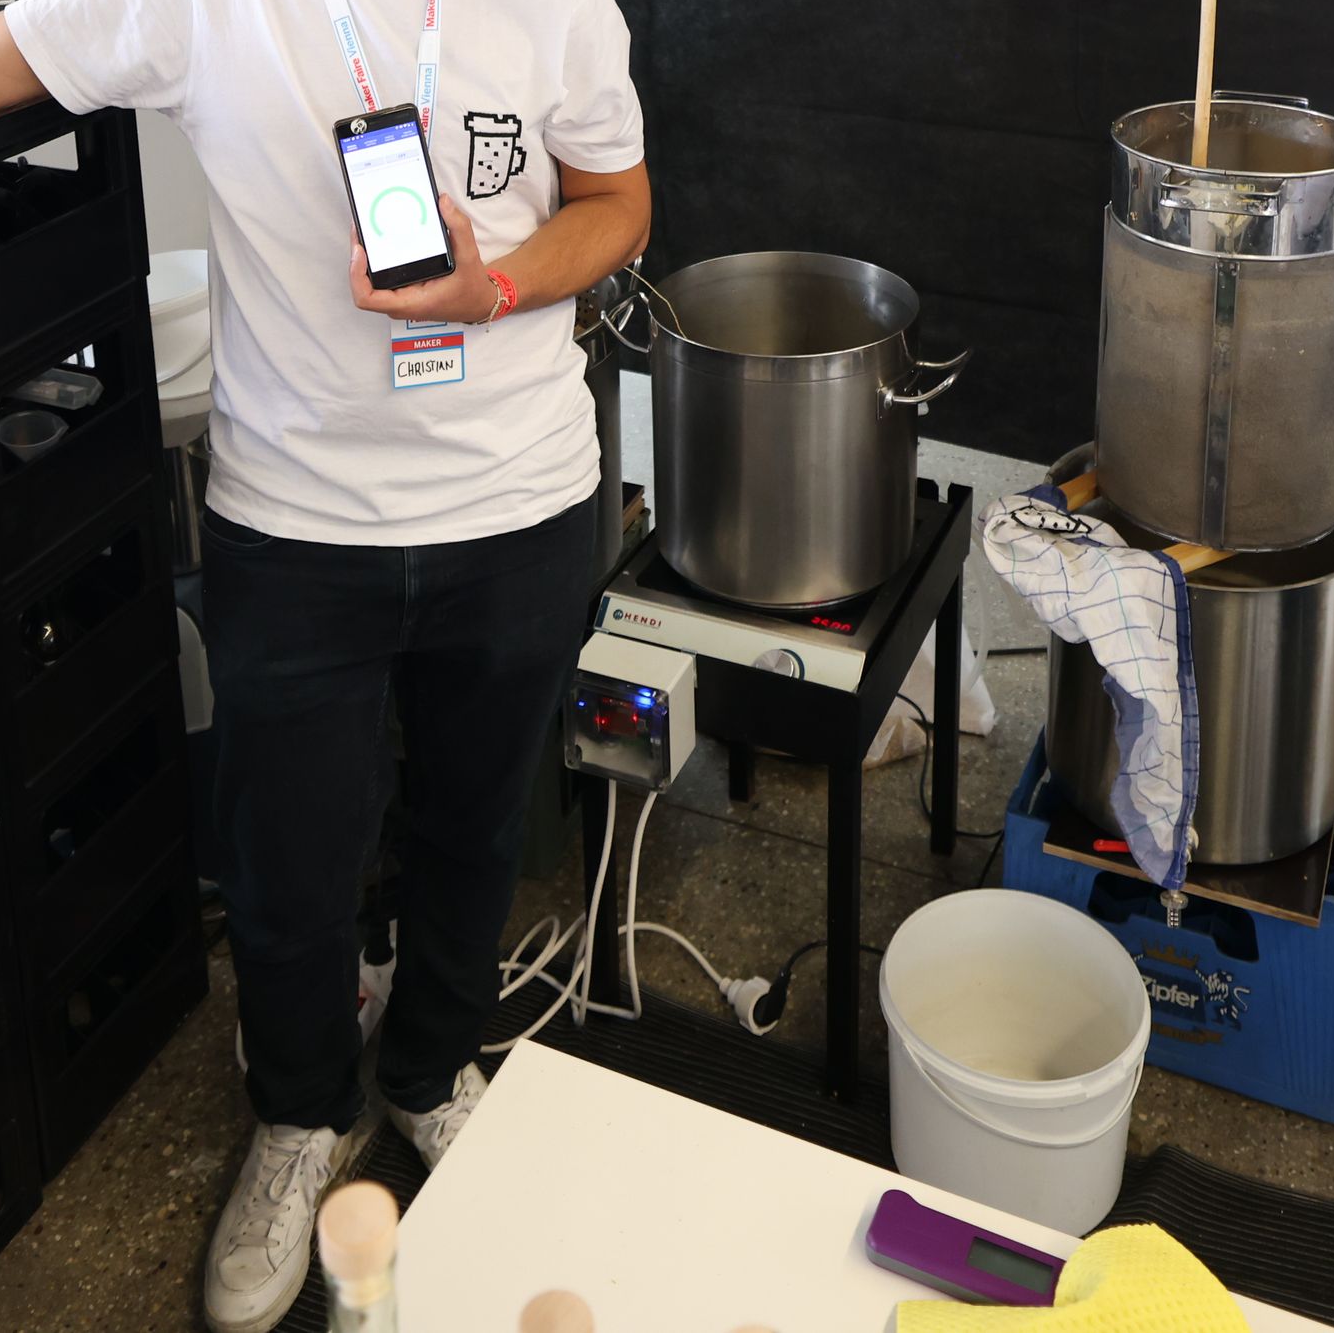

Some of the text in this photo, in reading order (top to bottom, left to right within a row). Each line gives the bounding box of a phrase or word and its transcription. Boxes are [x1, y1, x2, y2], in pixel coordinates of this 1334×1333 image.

[341, 21, 357, 58] Vienna
[353, 58, 366, 84] Faire
[421, 67, 432, 105] Vienna
[413, 338, 442, 349] MAKER
[397, 359, 454, 378] CHRISTIAN
[624, 612, 662, 627] HENDI
